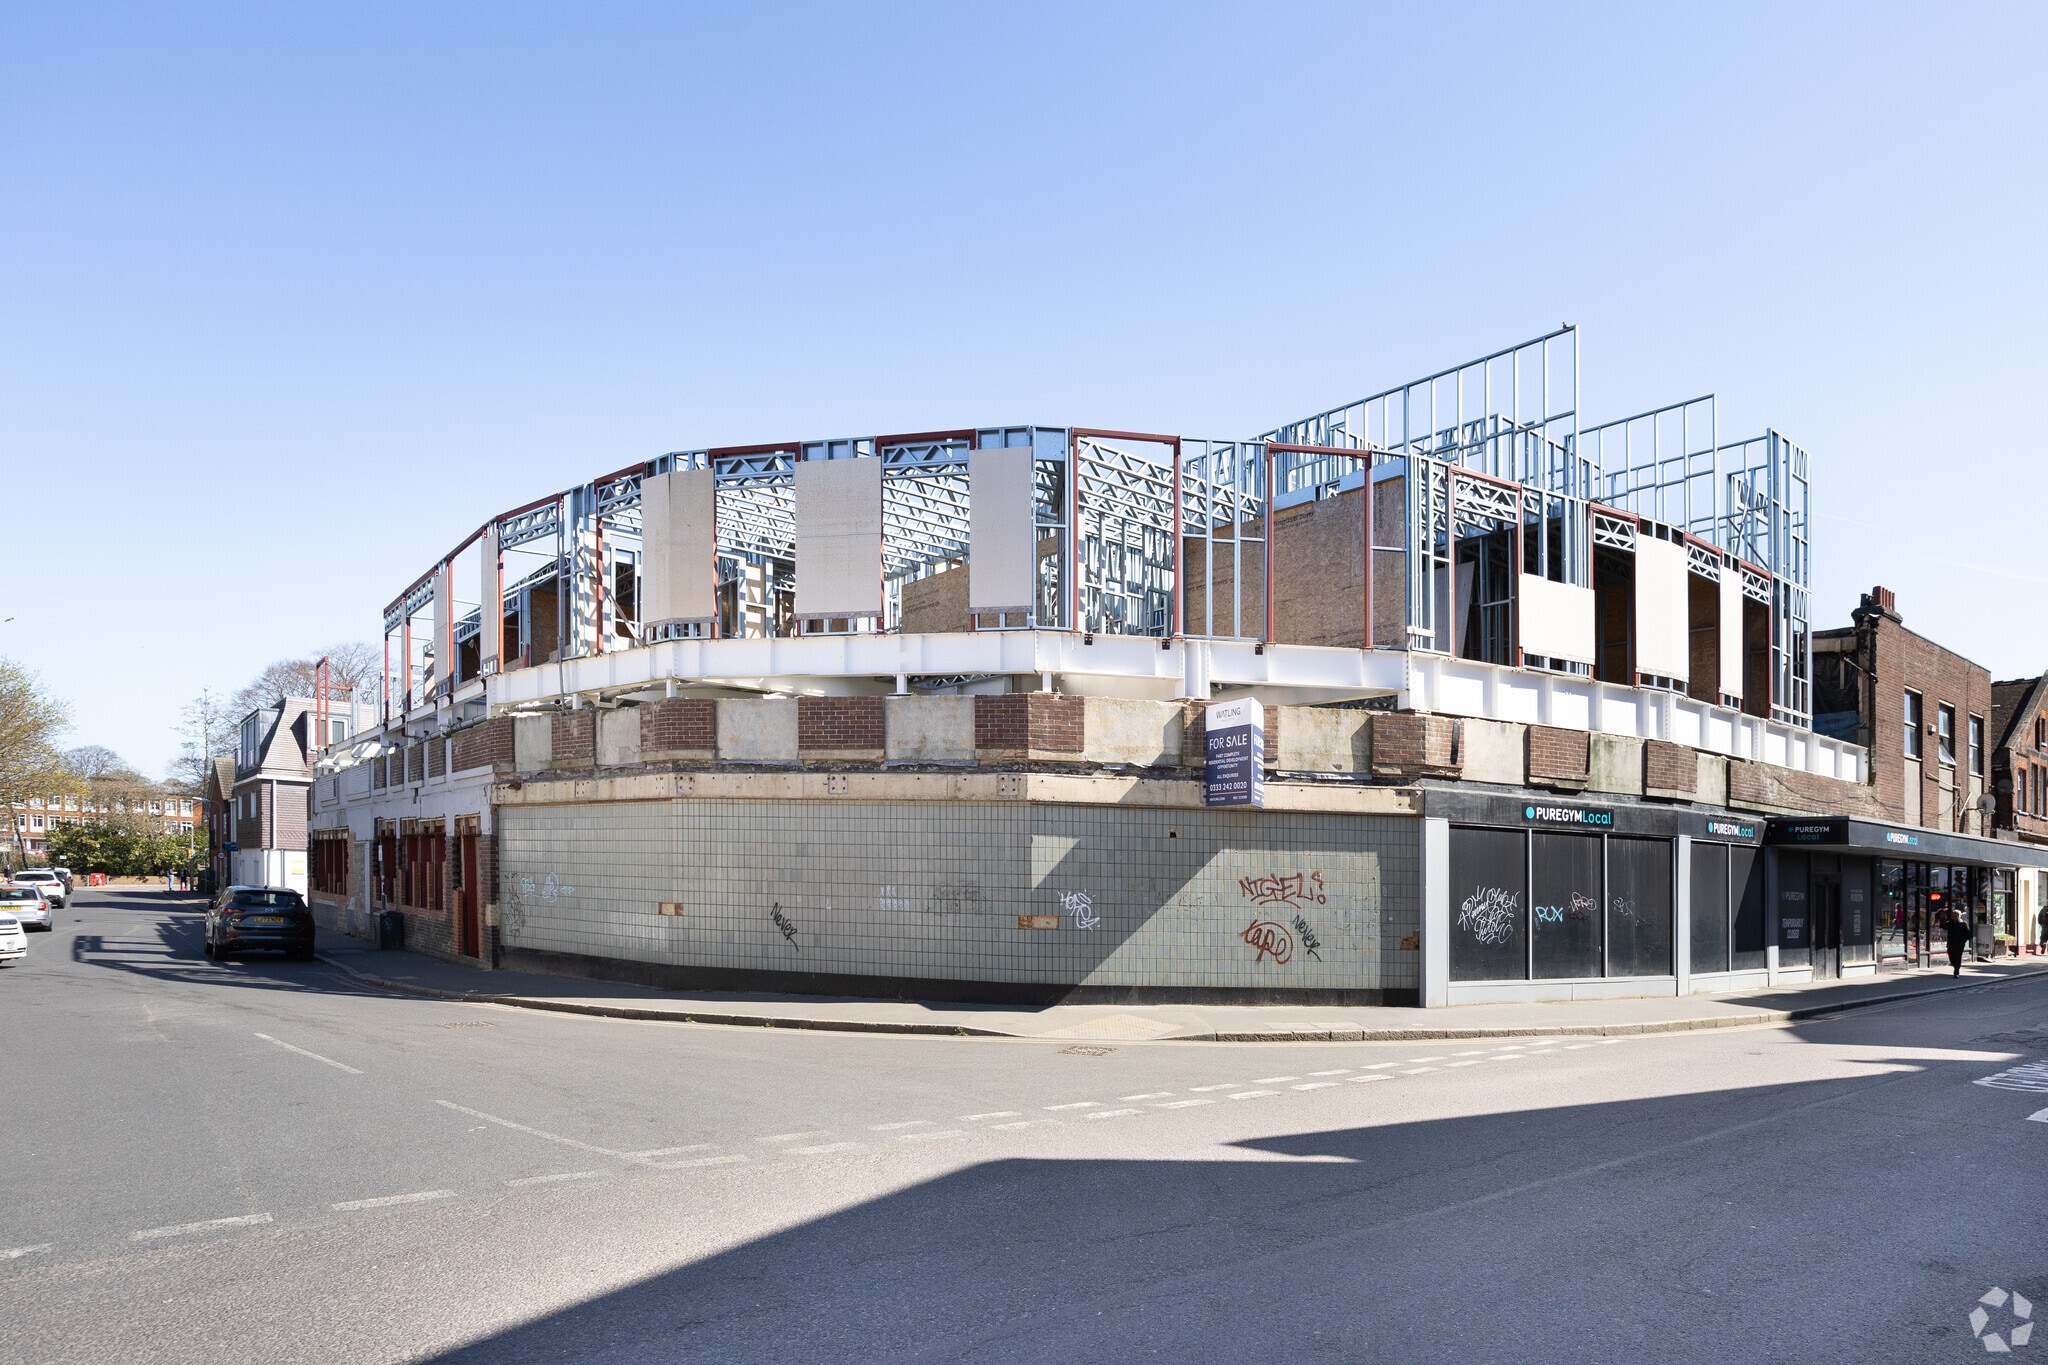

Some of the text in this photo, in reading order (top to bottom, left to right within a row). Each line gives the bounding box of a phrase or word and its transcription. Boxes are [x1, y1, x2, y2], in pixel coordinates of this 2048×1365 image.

[1216, 706, 1241, 719] WATLING
[1209, 737, 1225, 751] FOR
[1226, 733, 1248, 748] SALE
[1209, 783, 1222, 792] 0333
[1223, 783, 1233, 791] 242
[1233, 781, 1248, 790] 0020
[1794, 825, 1830, 833] PUREGYM
[1797, 833, 1819, 841] Local
